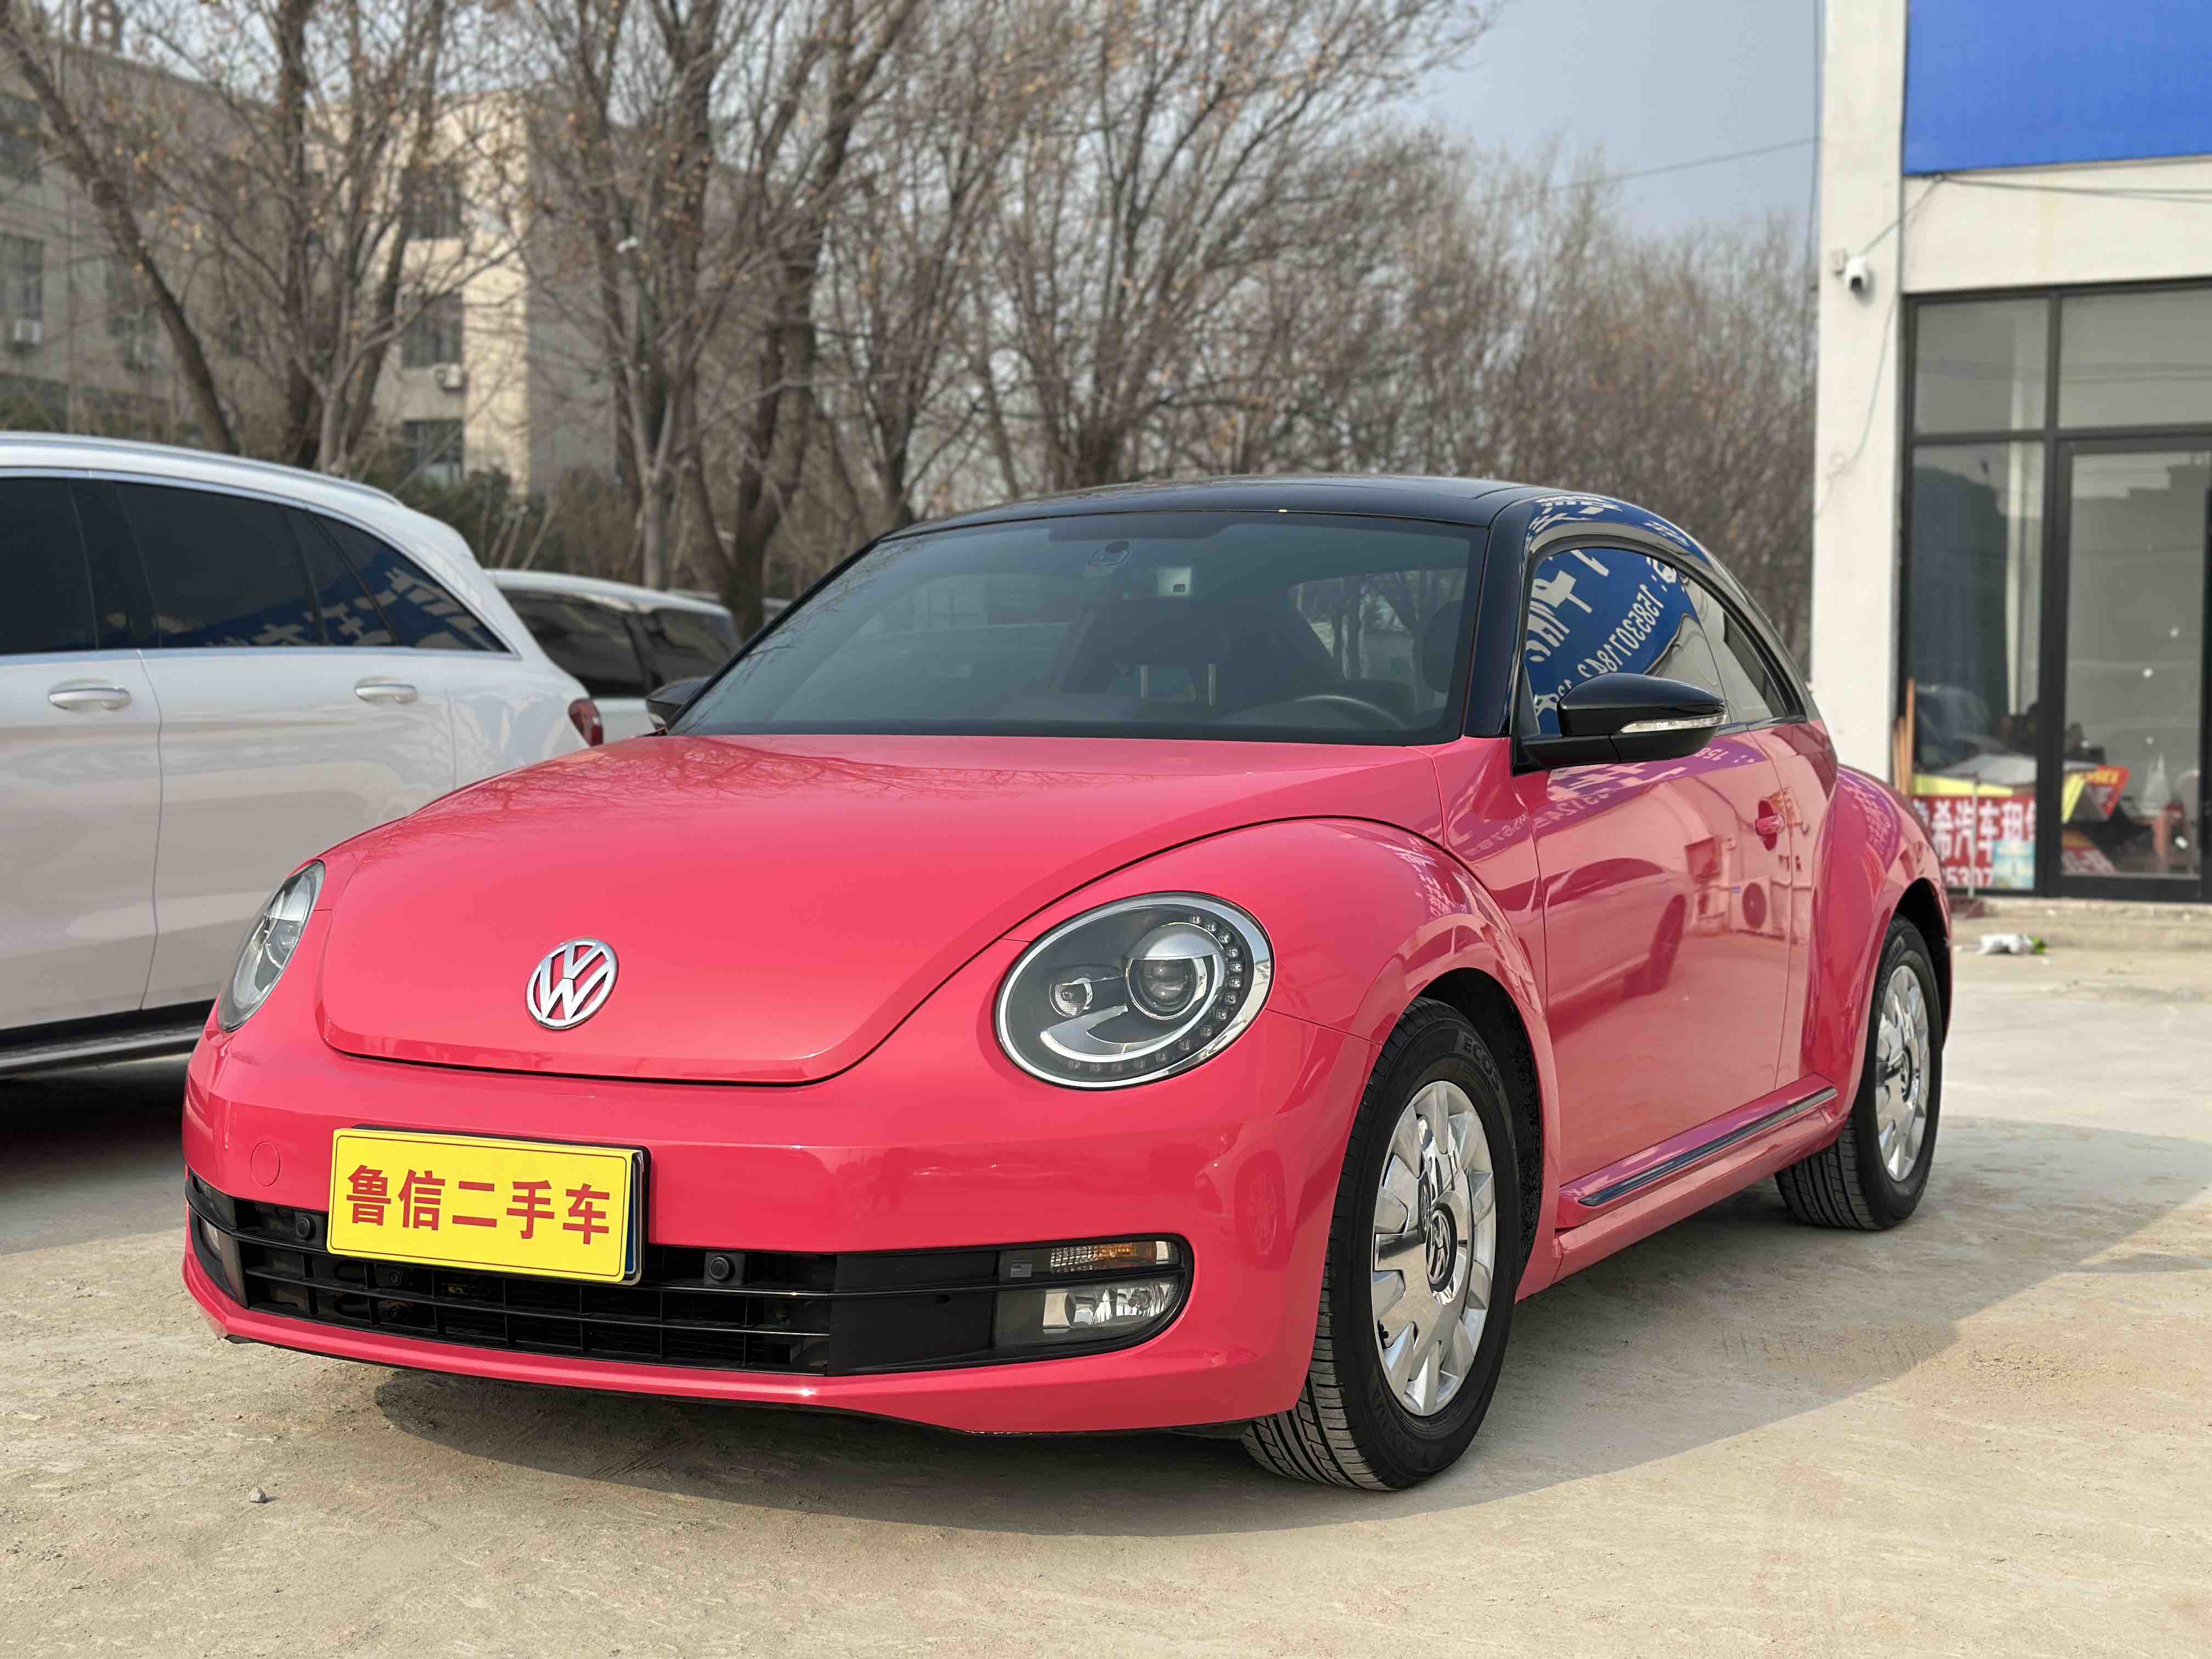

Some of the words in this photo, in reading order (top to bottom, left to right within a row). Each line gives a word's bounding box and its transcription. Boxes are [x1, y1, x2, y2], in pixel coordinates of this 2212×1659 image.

[346, 1165, 611, 1245] 鲁信二手车
